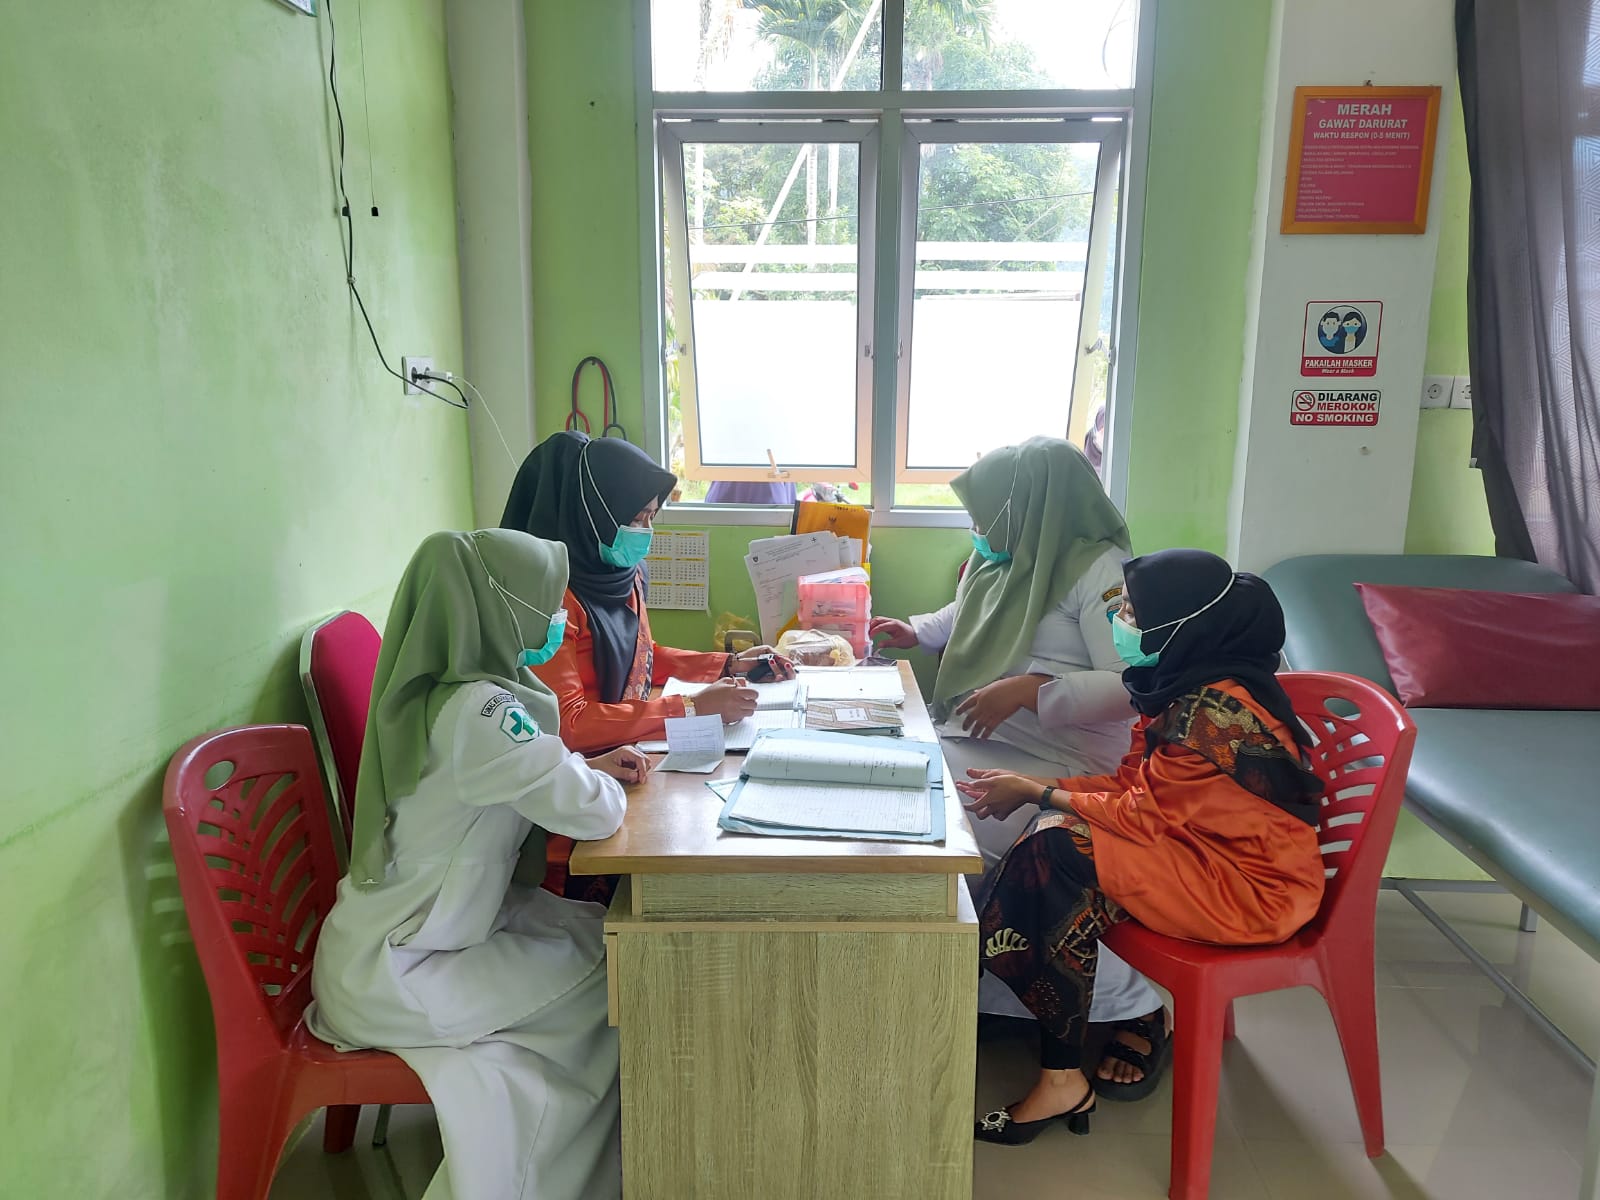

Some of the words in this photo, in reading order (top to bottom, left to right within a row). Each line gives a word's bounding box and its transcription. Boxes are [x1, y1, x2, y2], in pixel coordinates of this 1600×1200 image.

[1337, 104, 1392, 115] MERAH
[1318, 119, 1356, 129] GAWAT
[1358, 119, 1408, 129] DARURAT
[1385, 132, 1410, 140] MENIT)
[1305, 359, 1341, 368] PAKAILAH
[1342, 359, 1373, 368] MASKER
[1318, 393, 1377, 401] DILARANG
[1317, 403, 1375, 411] MEROKOK
[1295, 413, 1313, 422] NO
[1317, 413, 1374, 422] SMOKING
